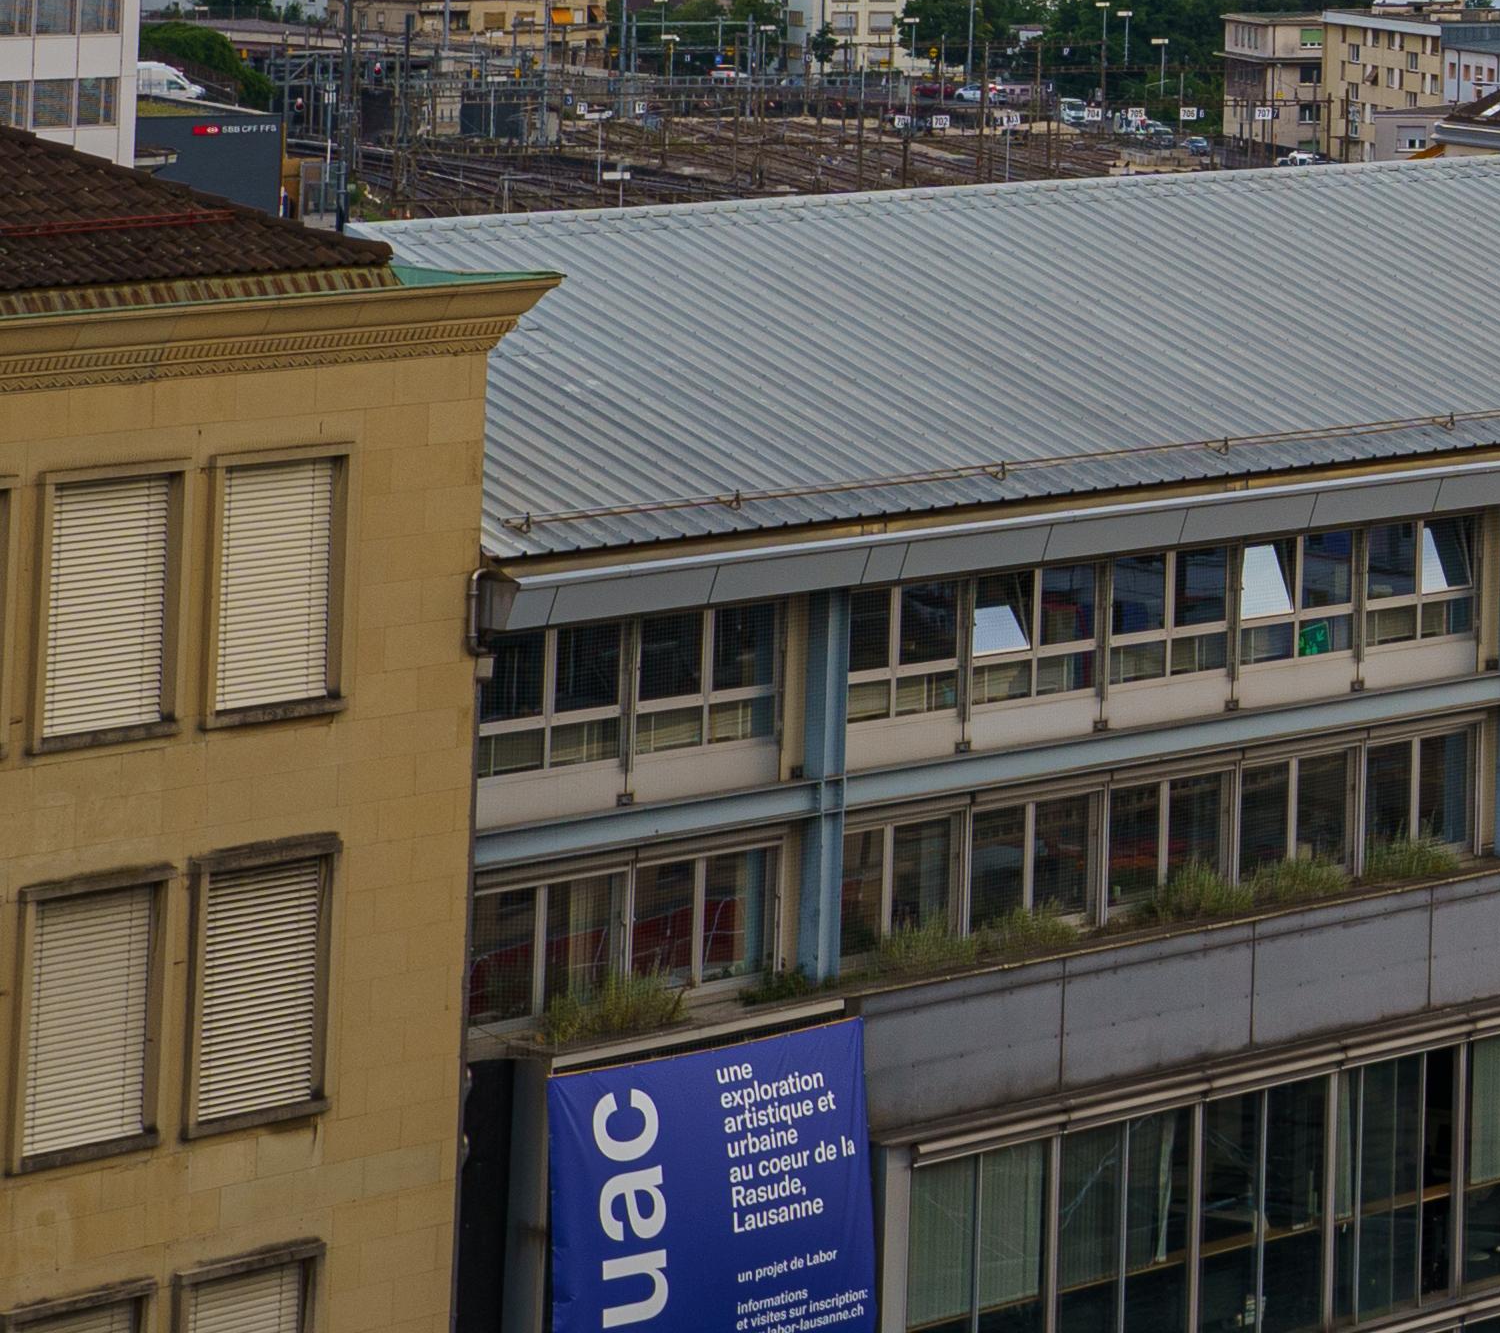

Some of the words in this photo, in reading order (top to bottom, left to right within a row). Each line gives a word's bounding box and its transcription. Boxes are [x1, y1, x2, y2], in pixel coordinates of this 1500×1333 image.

[241, 124, 257, 133] CFF
[260, 124, 277, 133] FFS
[1087, 109, 1100, 118] 704
[1257, 109, 1271, 118] 707
[716, 1063, 753, 1084] une
[720, 1071, 825, 1109] exploration
[724, 1099, 814, 1134] artistique
[817, 1090, 837, 1113] et
[727, 1127, 799, 1159] urbaine
[729, 1163, 754, 1184] au
[758, 1149, 811, 1177] coeur
[814, 1140, 838, 1164] de
[840, 1135, 856, 1158] la
[731, 1174, 807, 1209] Rasude,
[733, 1197, 824, 1234] Lausanne
[737, 1270, 753, 1283] un
[755, 1260, 788, 1282] projet
[790, 1256, 805, 1271] de
[806, 1249, 838, 1266] Labor
[736, 1317, 749, 1331] et
[750, 1309, 787, 1328] visites
[789, 1304, 808, 1319] sur
[809, 1288, 869, 1314] inscription:
[737, 1288, 809, 1315] informations
[738, 1303, 864, 1333] labor-lausanne.ch
